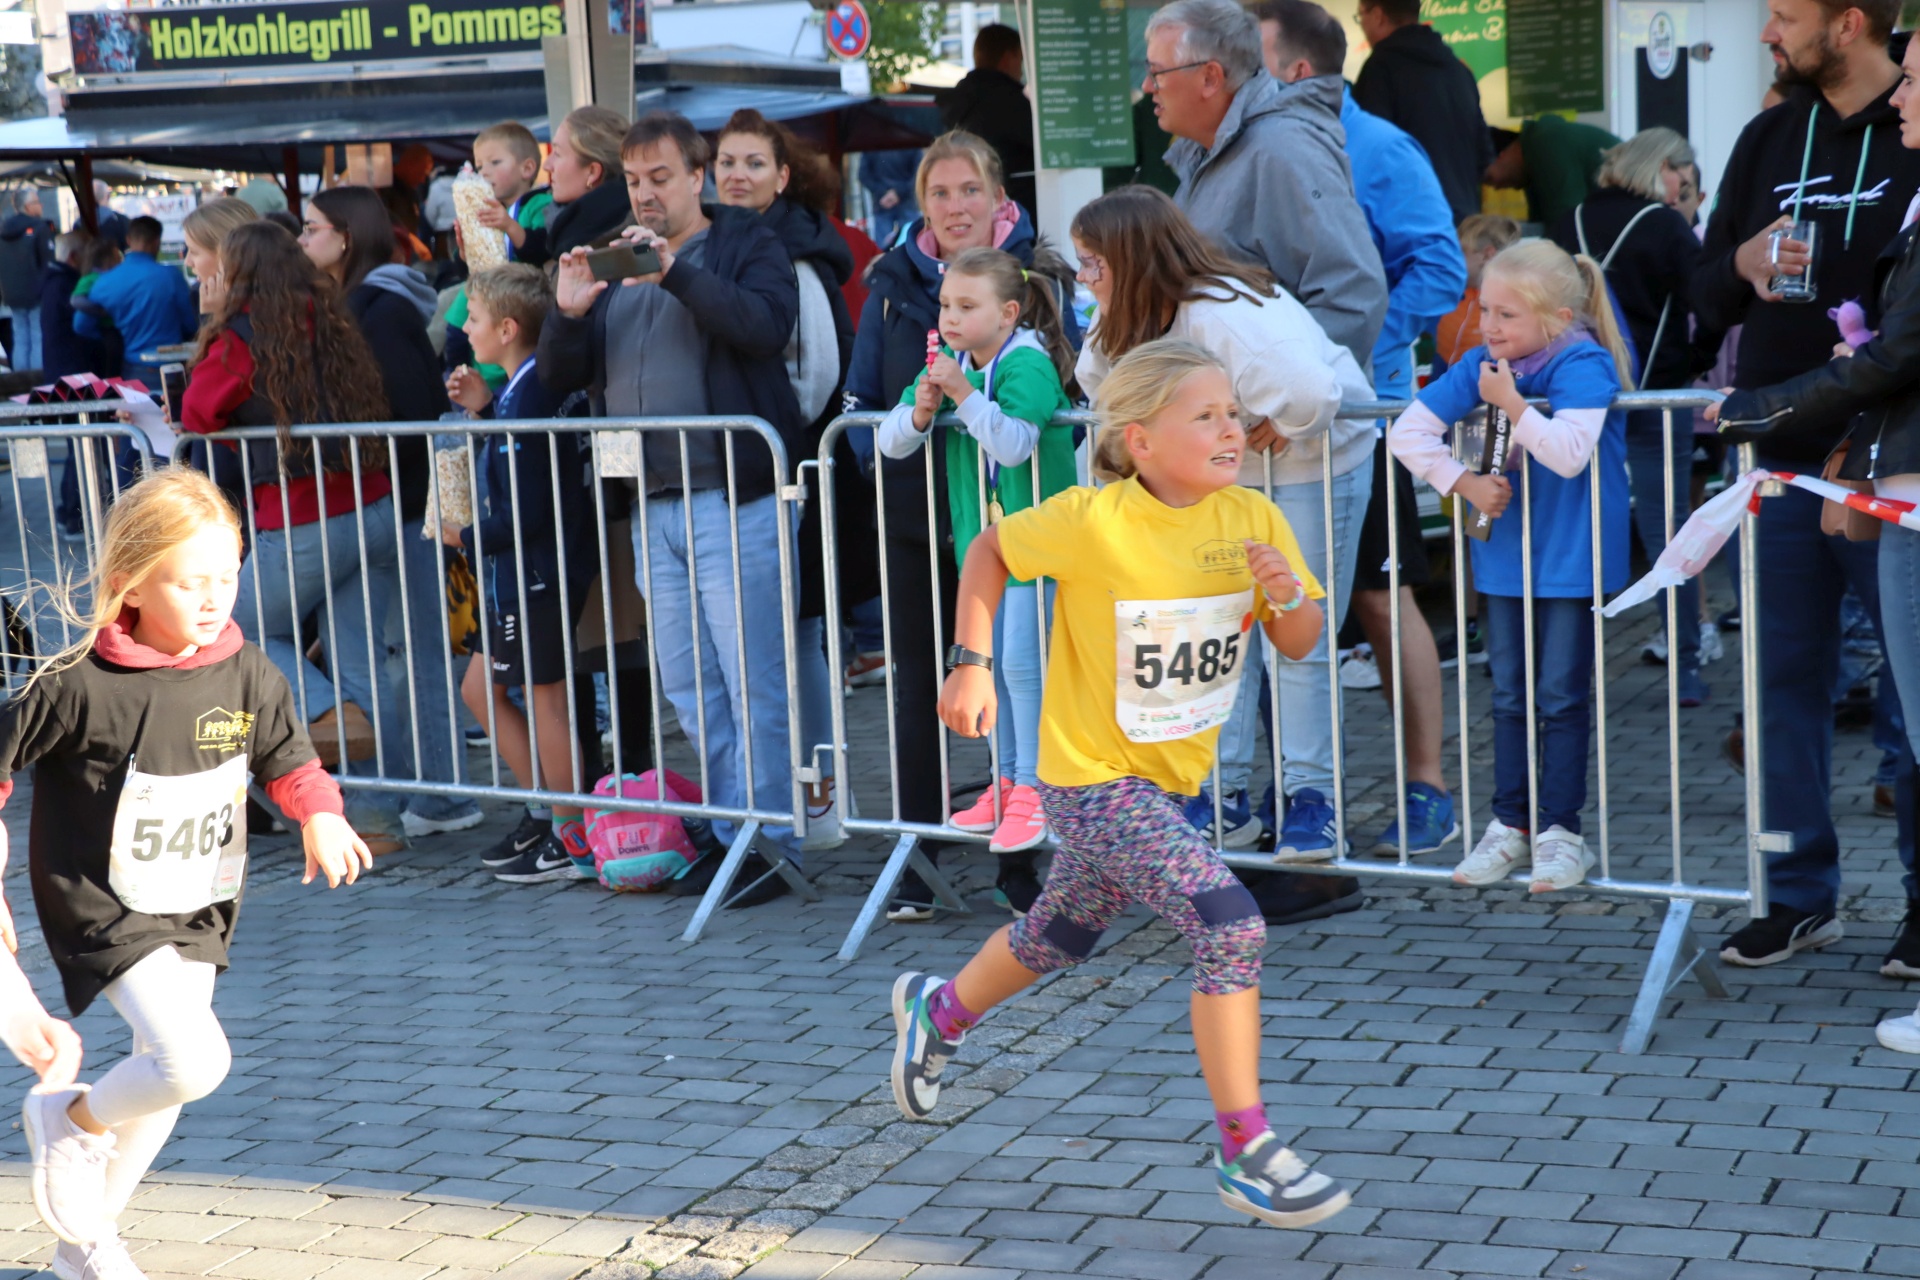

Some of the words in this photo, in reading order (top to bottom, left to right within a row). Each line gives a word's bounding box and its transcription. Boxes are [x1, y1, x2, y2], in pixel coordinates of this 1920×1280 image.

[151, 7, 373, 62] Holzkohlegrill
[383, 26, 398, 38] -
[408, 3, 562, 47] Pommes
[1492, 434, 1505, 467] NEUE
[1134, 632, 1240, 690] 5485
[131, 802, 234, 862] 5463
[616, 827, 650, 847] PUP
